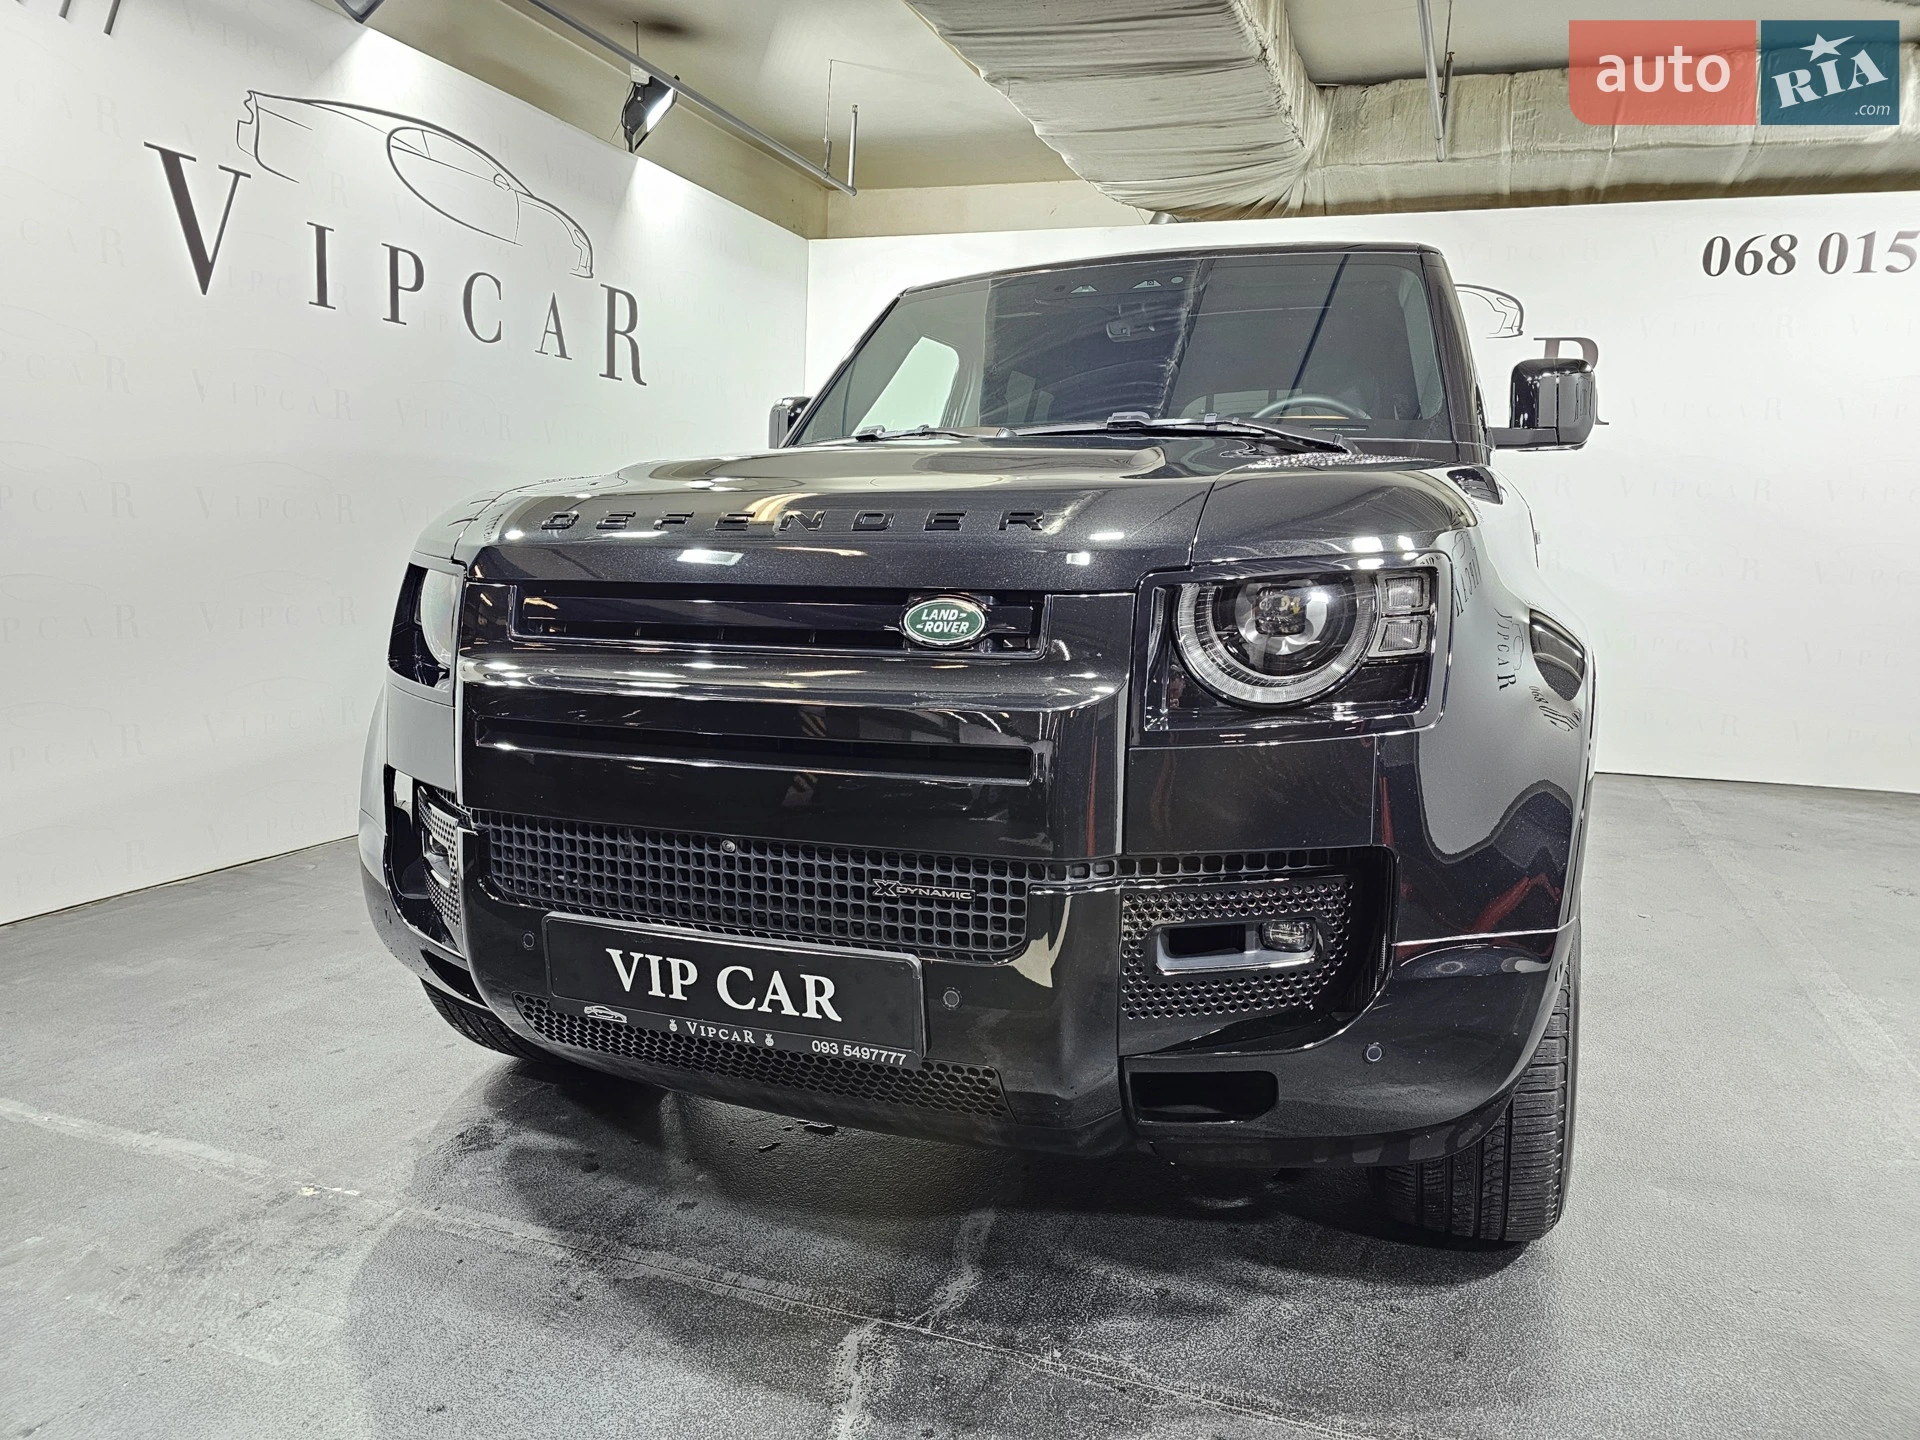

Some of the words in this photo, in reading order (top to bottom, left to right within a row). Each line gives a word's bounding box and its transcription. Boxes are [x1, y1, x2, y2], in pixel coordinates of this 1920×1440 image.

[143, 141, 648, 387] VIPCAR
[1702, 233, 1798, 277] 068
[1817, 230, 1920, 275] 015
[541, 508, 1046, 534] DEFENDER
[605, 948, 698, 1001] VIP
[716, 965, 842, 1022] CAR
[811, 1040, 840, 1056] 093
[842, 1044, 908, 1066] 5497777
